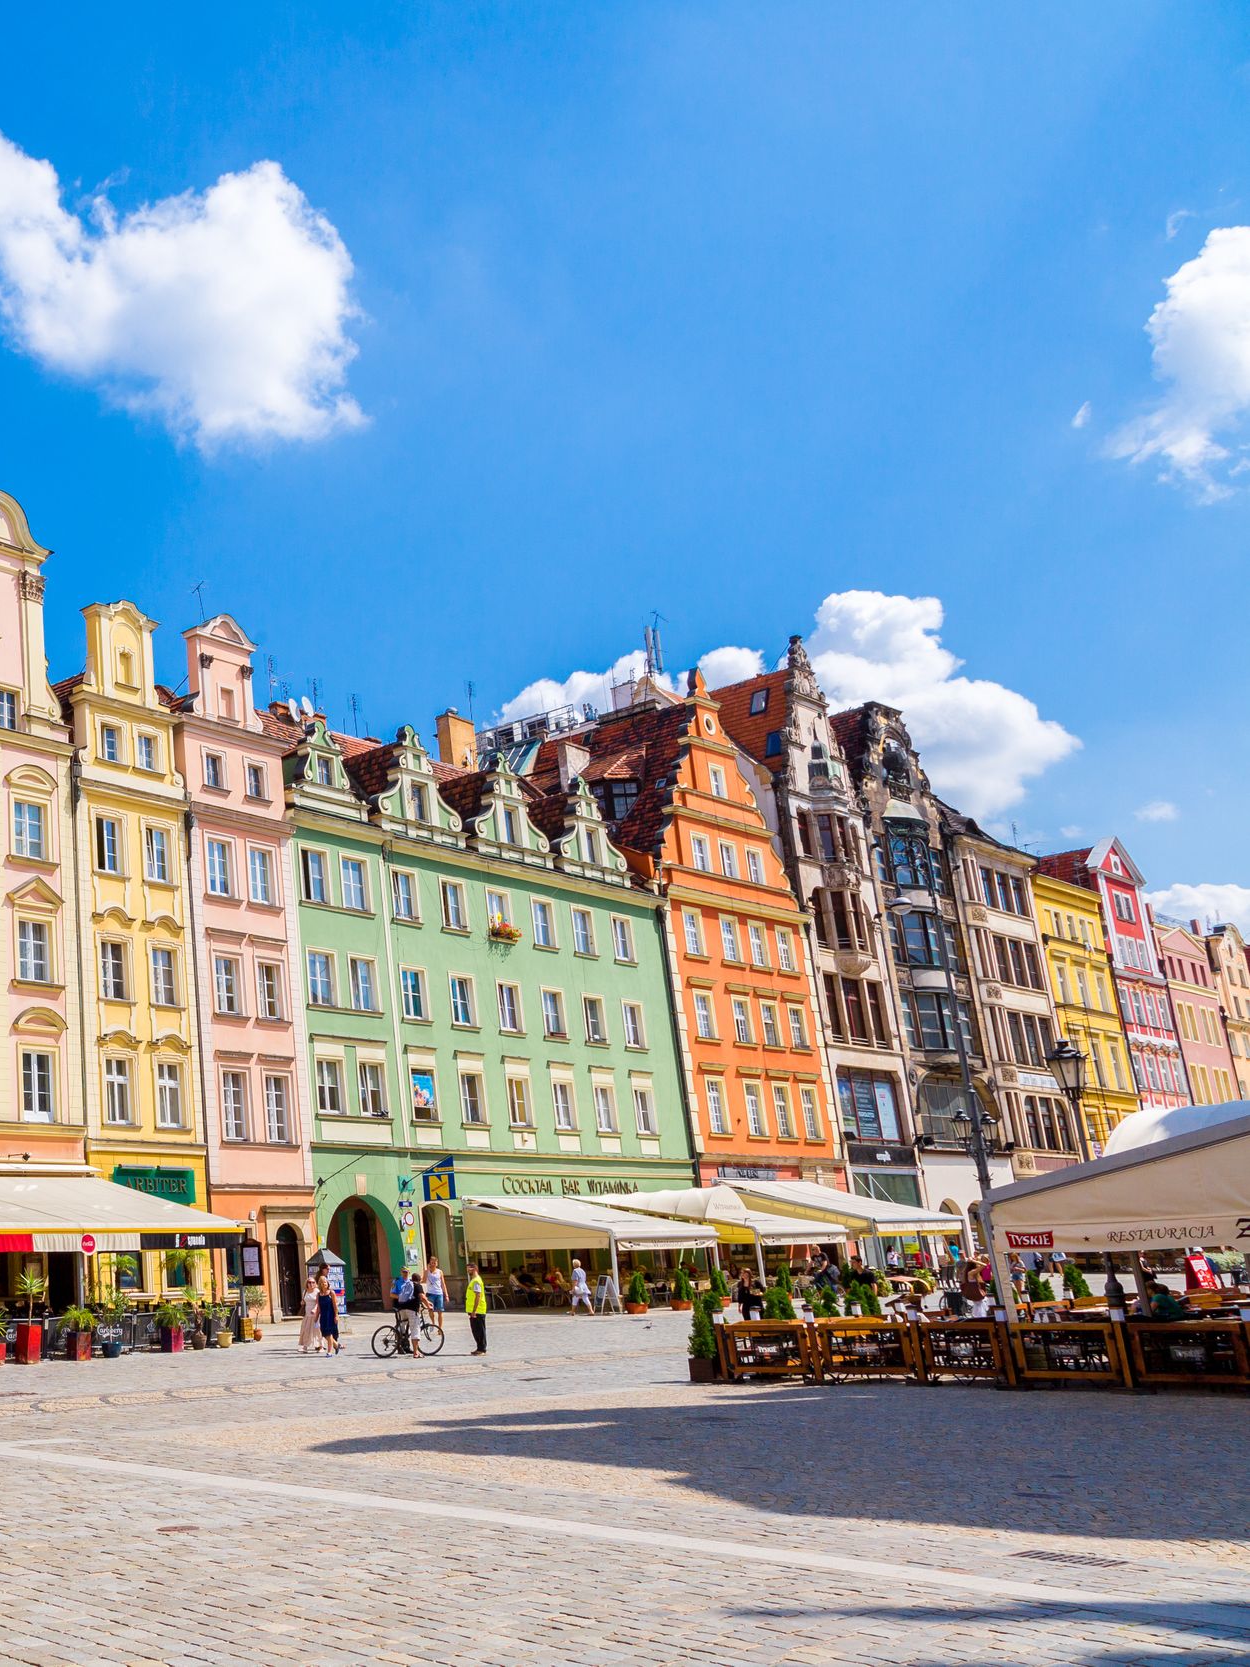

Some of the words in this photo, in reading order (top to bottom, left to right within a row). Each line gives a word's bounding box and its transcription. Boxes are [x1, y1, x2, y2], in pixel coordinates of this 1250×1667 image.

[125, 1176, 188, 1193] ARBITER
[502, 1176, 554, 1195] COCKTAIL
[561, 1178, 580, 1195] BAR
[1008, 1232, 1051, 1247] TYSKIE
[1107, 1226, 1216, 1244] RESTAURACJA
